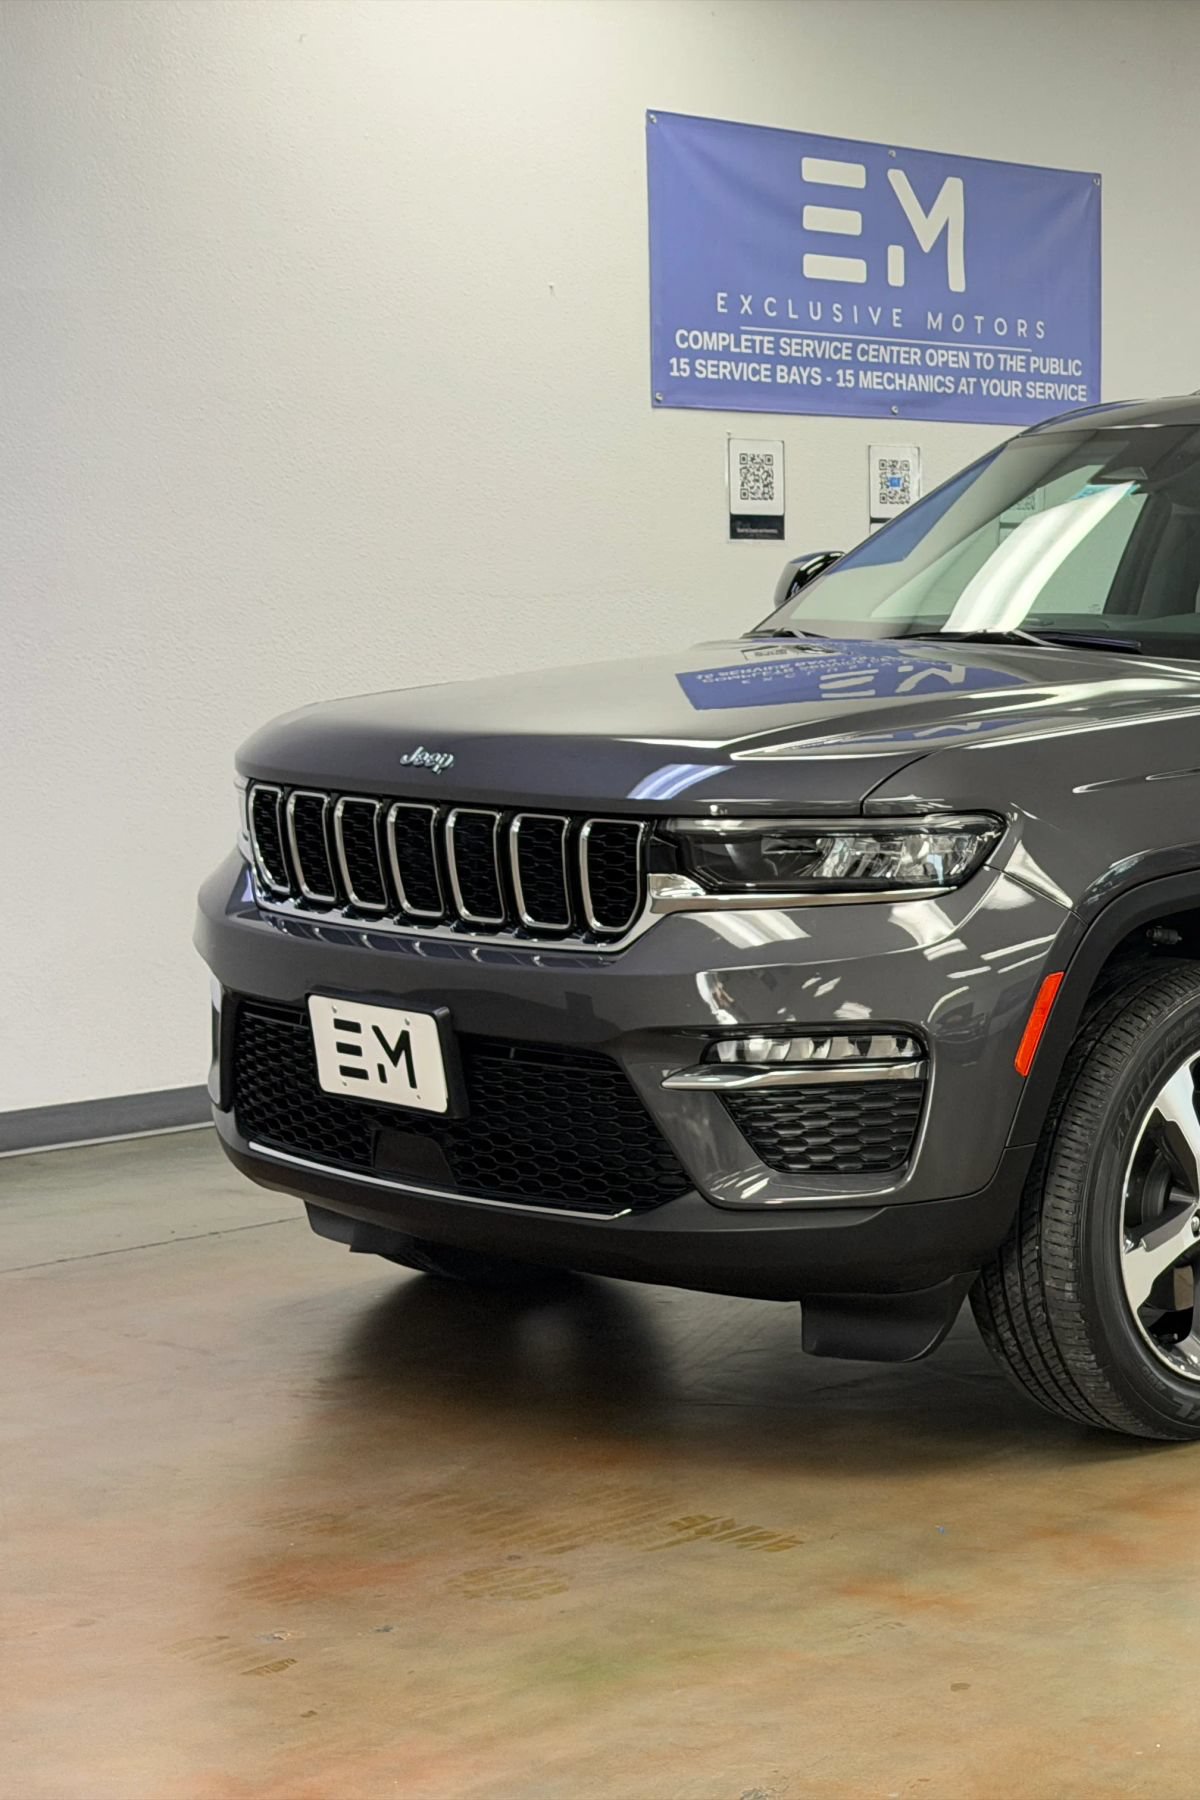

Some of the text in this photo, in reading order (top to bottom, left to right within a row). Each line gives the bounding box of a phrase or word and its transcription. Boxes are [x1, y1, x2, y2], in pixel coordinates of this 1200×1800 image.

[801, 156, 967, 293] EM
[717, 292, 1046, 339] EXCLUSIVE MOTORS
[675, 329, 1083, 377] COMPLETE SERVICE CENTER OPEN TO THE PUBLIC
[669, 357, 690, 377] 15
[694, 359, 772, 382] SERVICE
[776, 365, 822, 386] BAYS
[836, 369, 855, 388] 15
[859, 370, 955, 394] MECHANICS
[958, 377, 976, 396] AT
[980, 378, 1023, 398] YOUR
[1025, 381, 1088, 402] SERVICE
[400, 746, 454, 775] Jeep
[333, 1017, 418, 1090] EM
